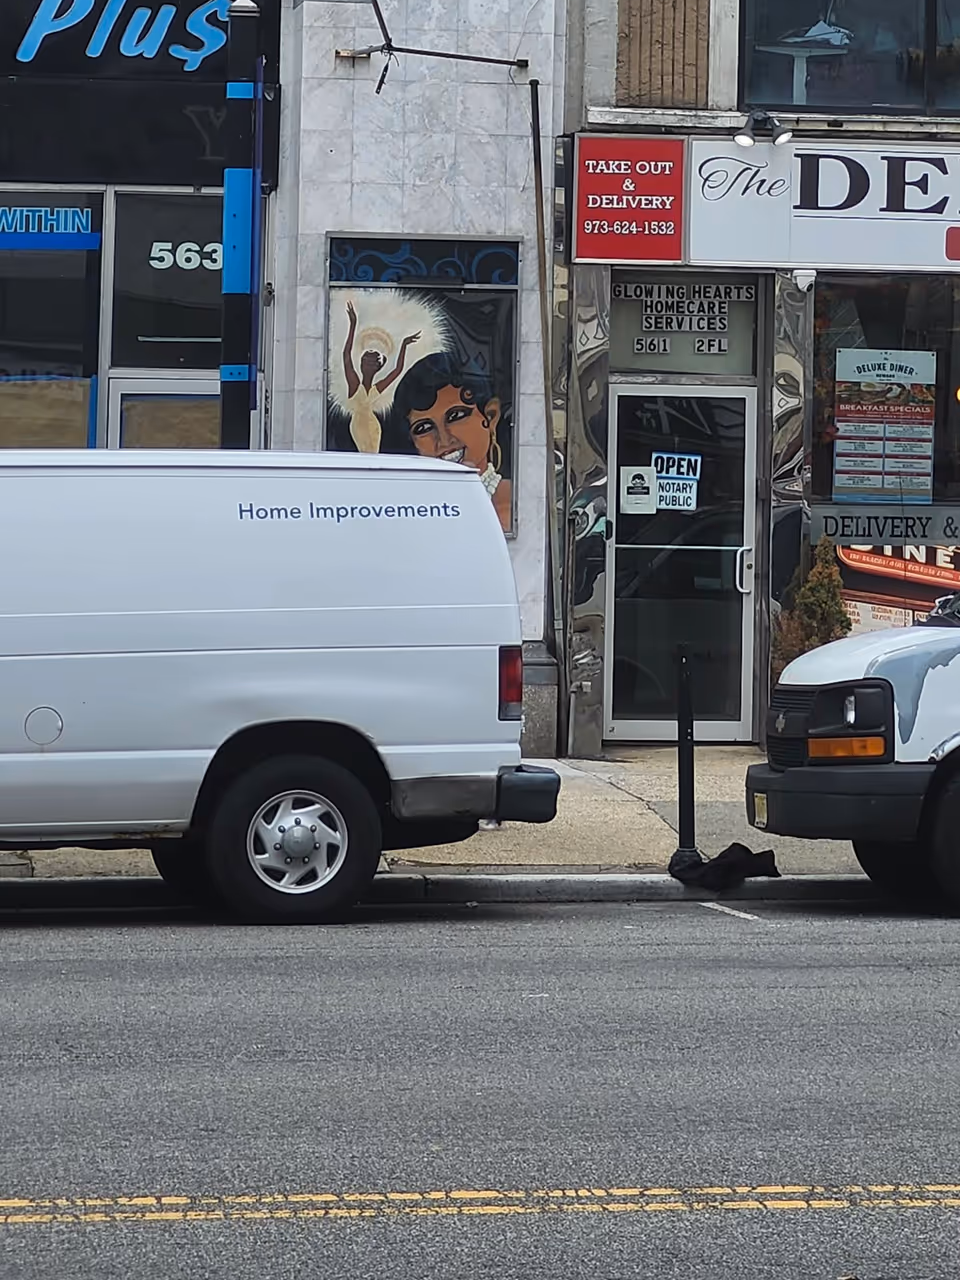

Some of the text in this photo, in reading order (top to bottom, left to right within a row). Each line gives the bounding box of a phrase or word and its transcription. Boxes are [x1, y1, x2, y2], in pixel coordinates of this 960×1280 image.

[585, 160, 673, 176] TAKE OUT
[622, 179, 636, 192] &
[698, 155, 790, 202] The
[587, 194, 675, 210] DELIVERY
[584, 220, 675, 236] 973-624-1532
[149, 241, 223, 270] 563
[612, 283, 755, 301] GLOWING HEARTS
[643, 300, 728, 315] HOMECARE
[642, 315, 728, 331] SERVICES
[634, 338, 728, 354] 561 2FL
[855, 362, 915, 377] DELUXE DINER
[839, 404, 889, 412] BREAKFAST
[889, 405, 931, 413] SPECIALS
[654, 455, 698, 477] OPEN
[658, 481, 694, 494] NOTARY
[658, 494, 692, 507] PUBLIC
[237, 501, 461, 523] Home Improvements
[823, 515, 932, 539] DELIVERY
[943, 516, 959, 539] &
